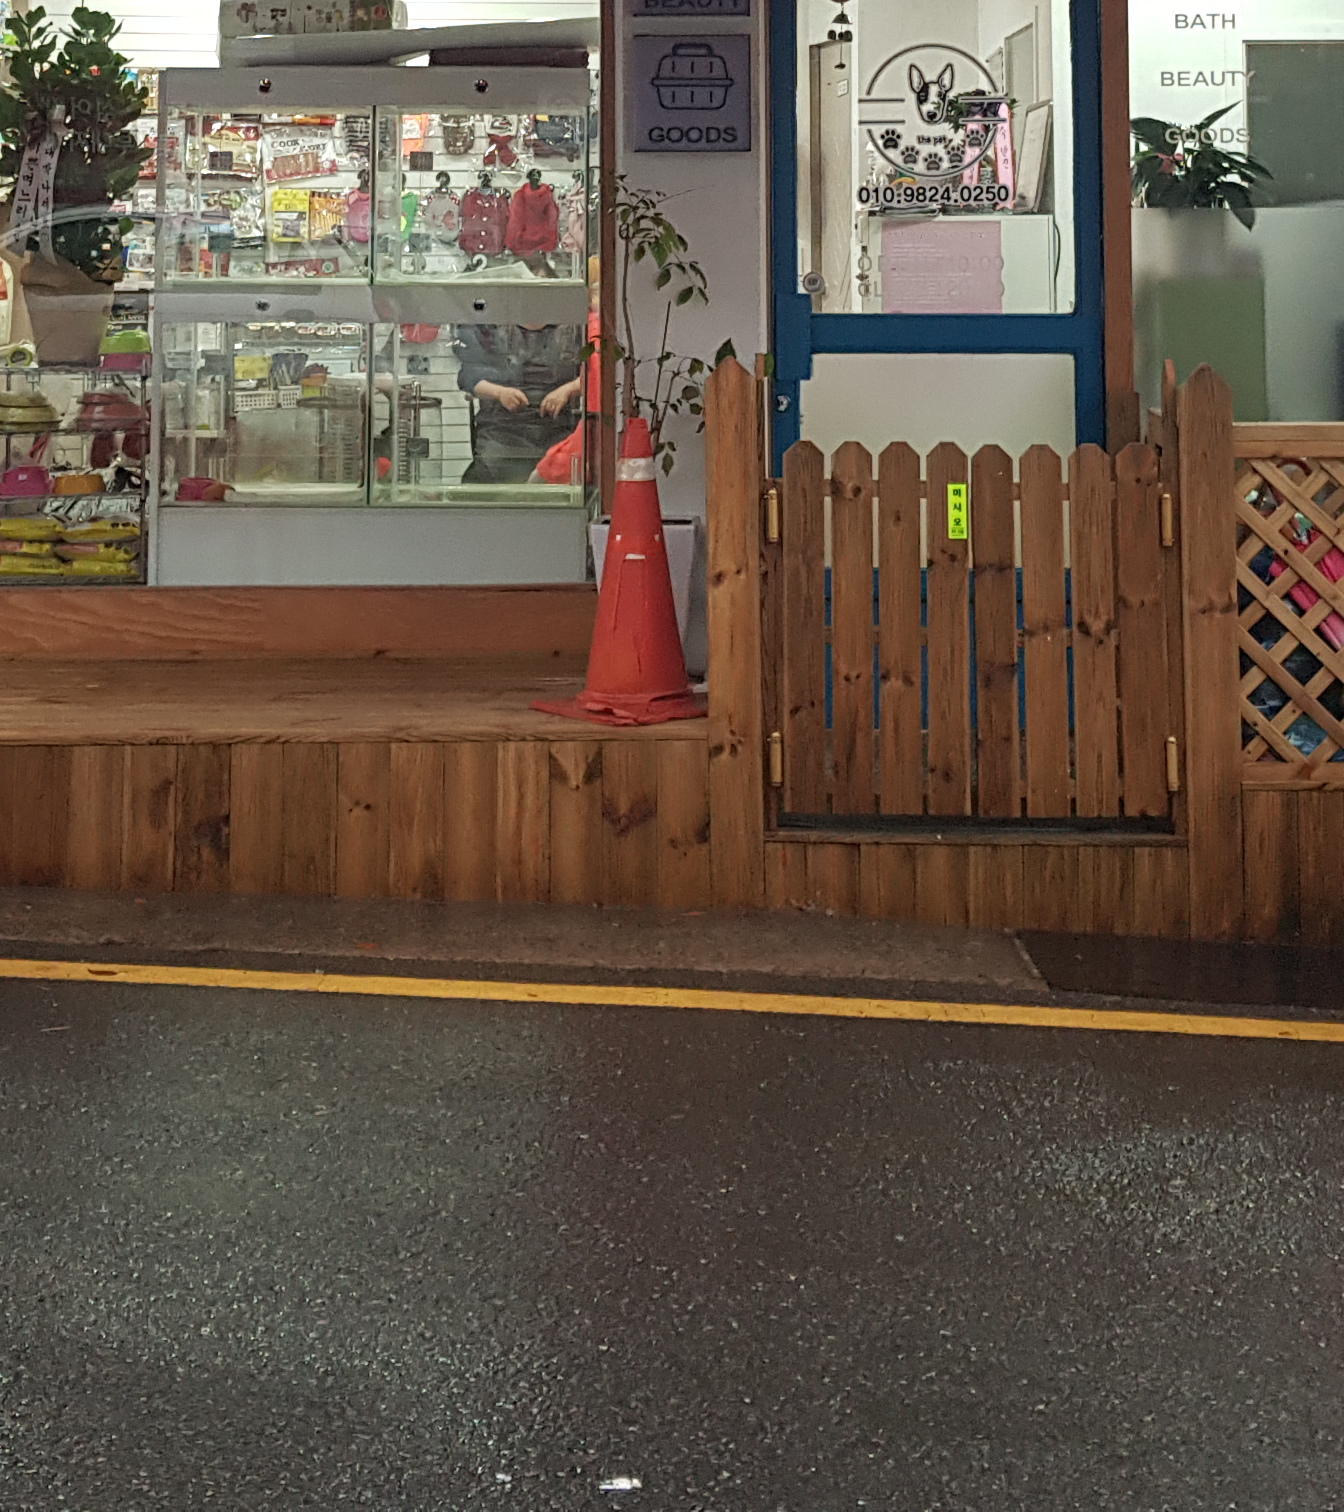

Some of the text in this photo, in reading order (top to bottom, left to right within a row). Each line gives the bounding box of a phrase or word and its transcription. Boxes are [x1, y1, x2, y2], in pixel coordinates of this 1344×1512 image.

[1173, 13, 1236, 30] BATH
[1159, 70, 1256, 88] BEAUTY
[648, 126, 738, 144] GOODS
[1164, 127, 1251, 145] GOODS
[858, 185, 1009, 205] 010.9824.0250
[953, 488, 962, 527] 미시오
